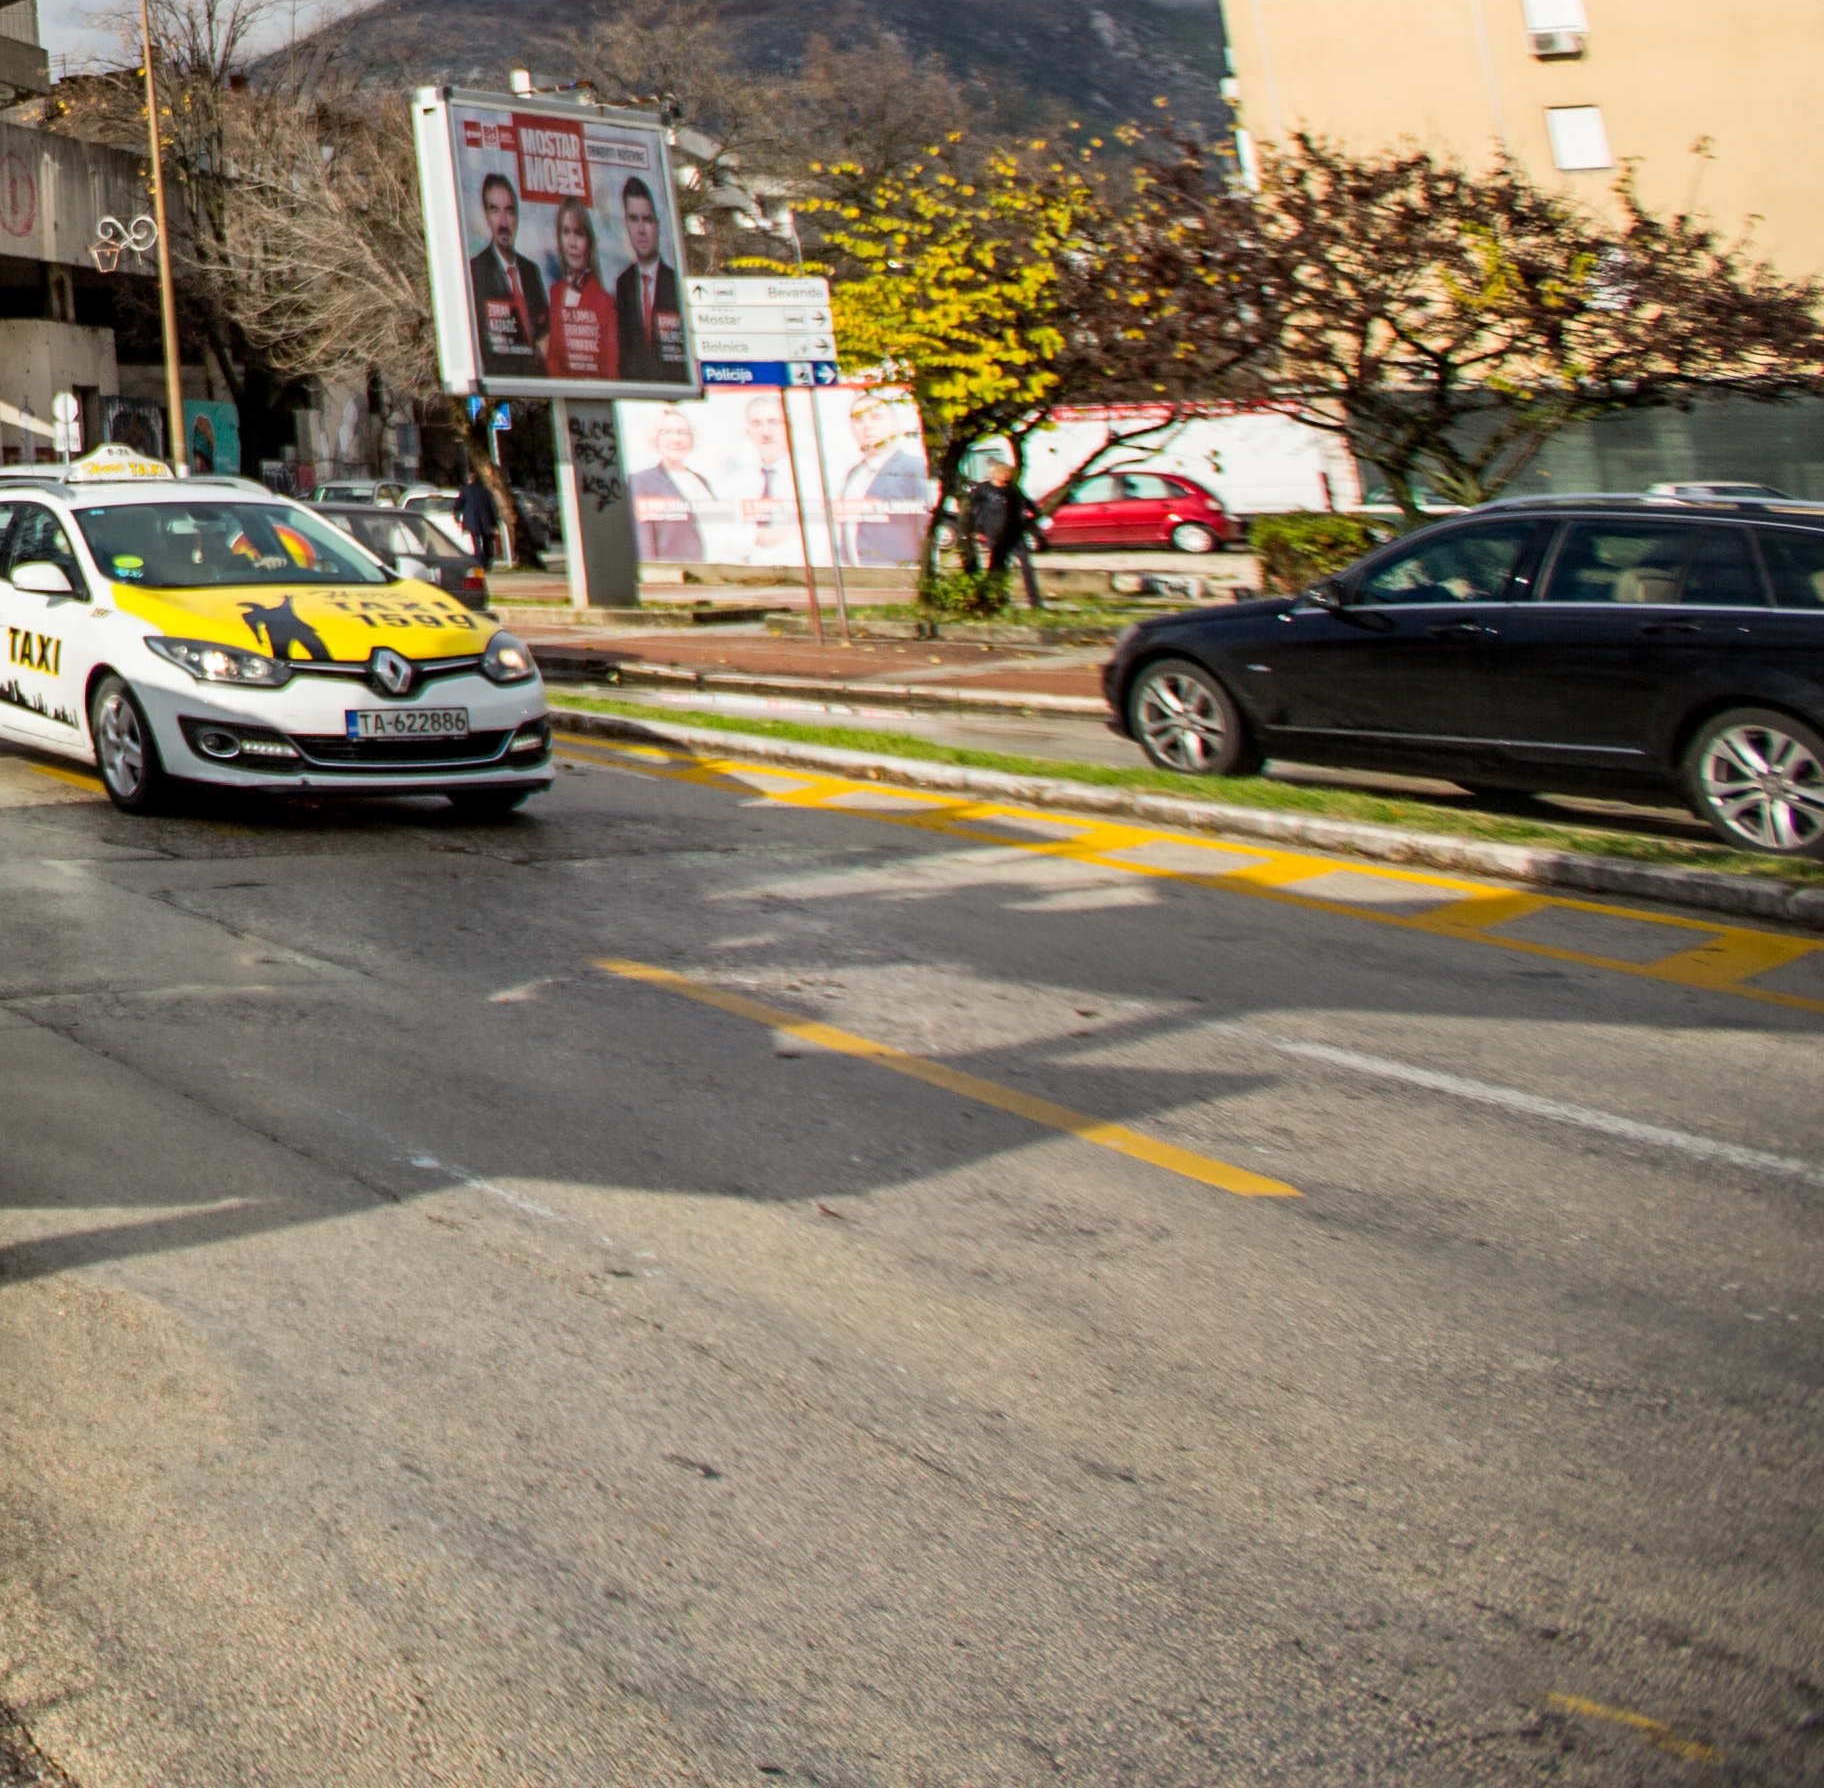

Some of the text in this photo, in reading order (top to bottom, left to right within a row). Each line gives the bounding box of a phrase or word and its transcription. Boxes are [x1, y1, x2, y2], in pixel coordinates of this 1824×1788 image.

[520, 127, 581, 160] MOSTAR
[768, 286, 824, 299] Bevanda
[698, 314, 742, 325] Mostar
[702, 341, 749, 353] Bolnica
[706, 367, 754, 383] Policija
[128, 462, 167, 477] TAXI
[324, 601, 451, 611] TAXI
[352, 613, 479, 630] 1599
[8, 626, 62, 677] TAXI
[360, 713, 466, 735] TA-622886
